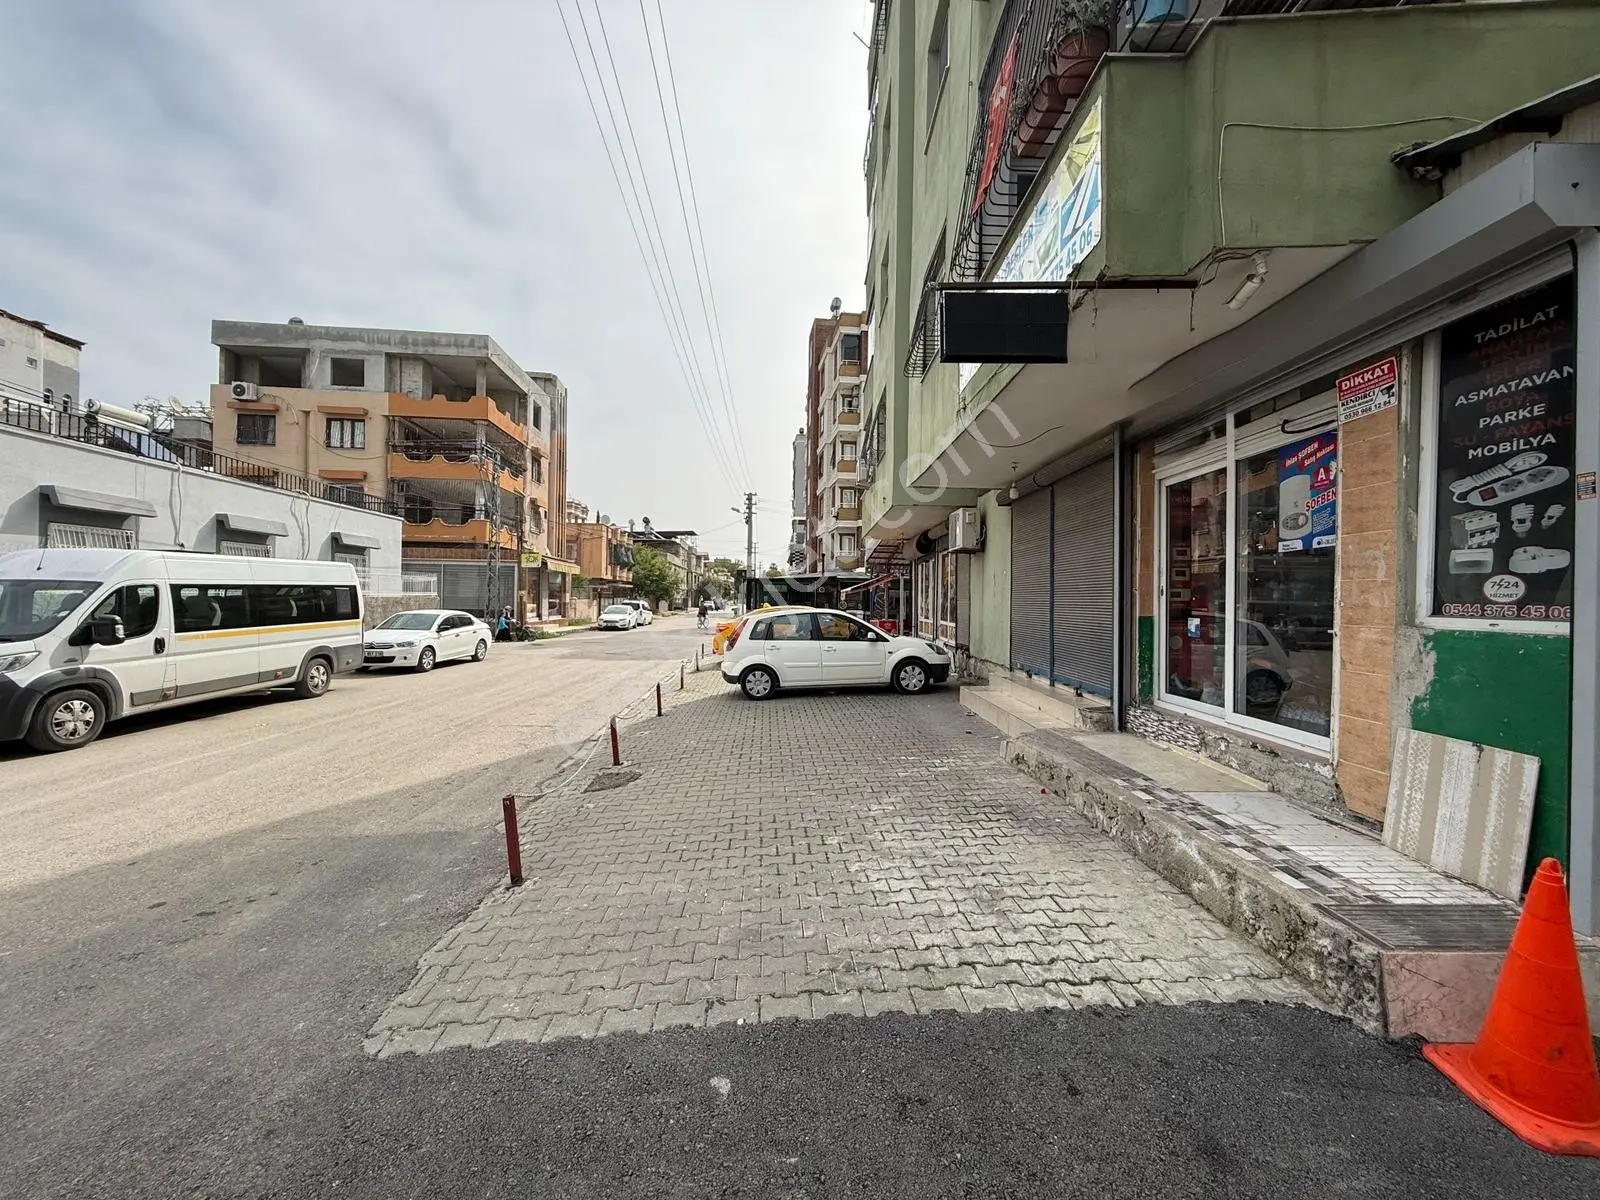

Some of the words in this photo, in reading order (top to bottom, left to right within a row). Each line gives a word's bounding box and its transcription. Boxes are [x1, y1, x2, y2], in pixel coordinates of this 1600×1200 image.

[1080, 220, 1093, 254] 06
[1474, 306, 1559, 343] TADİLAT
[1341, 363, 1391, 390] DİKKAT
[1486, 392, 1539, 413] BOYA
[1479, 403, 1546, 430] PARKE
[1495, 412, 1574, 439] FAYANS
[1468, 433, 1557, 460] MOBİLYA
[1318, 467, 1326, 480] A
[1442, 603, 1481, 616] 0544
[1484, 604, 1517, 617] 375
[1520, 605, 1545, 618] 45
[1549, 606, 1570, 619] 06
